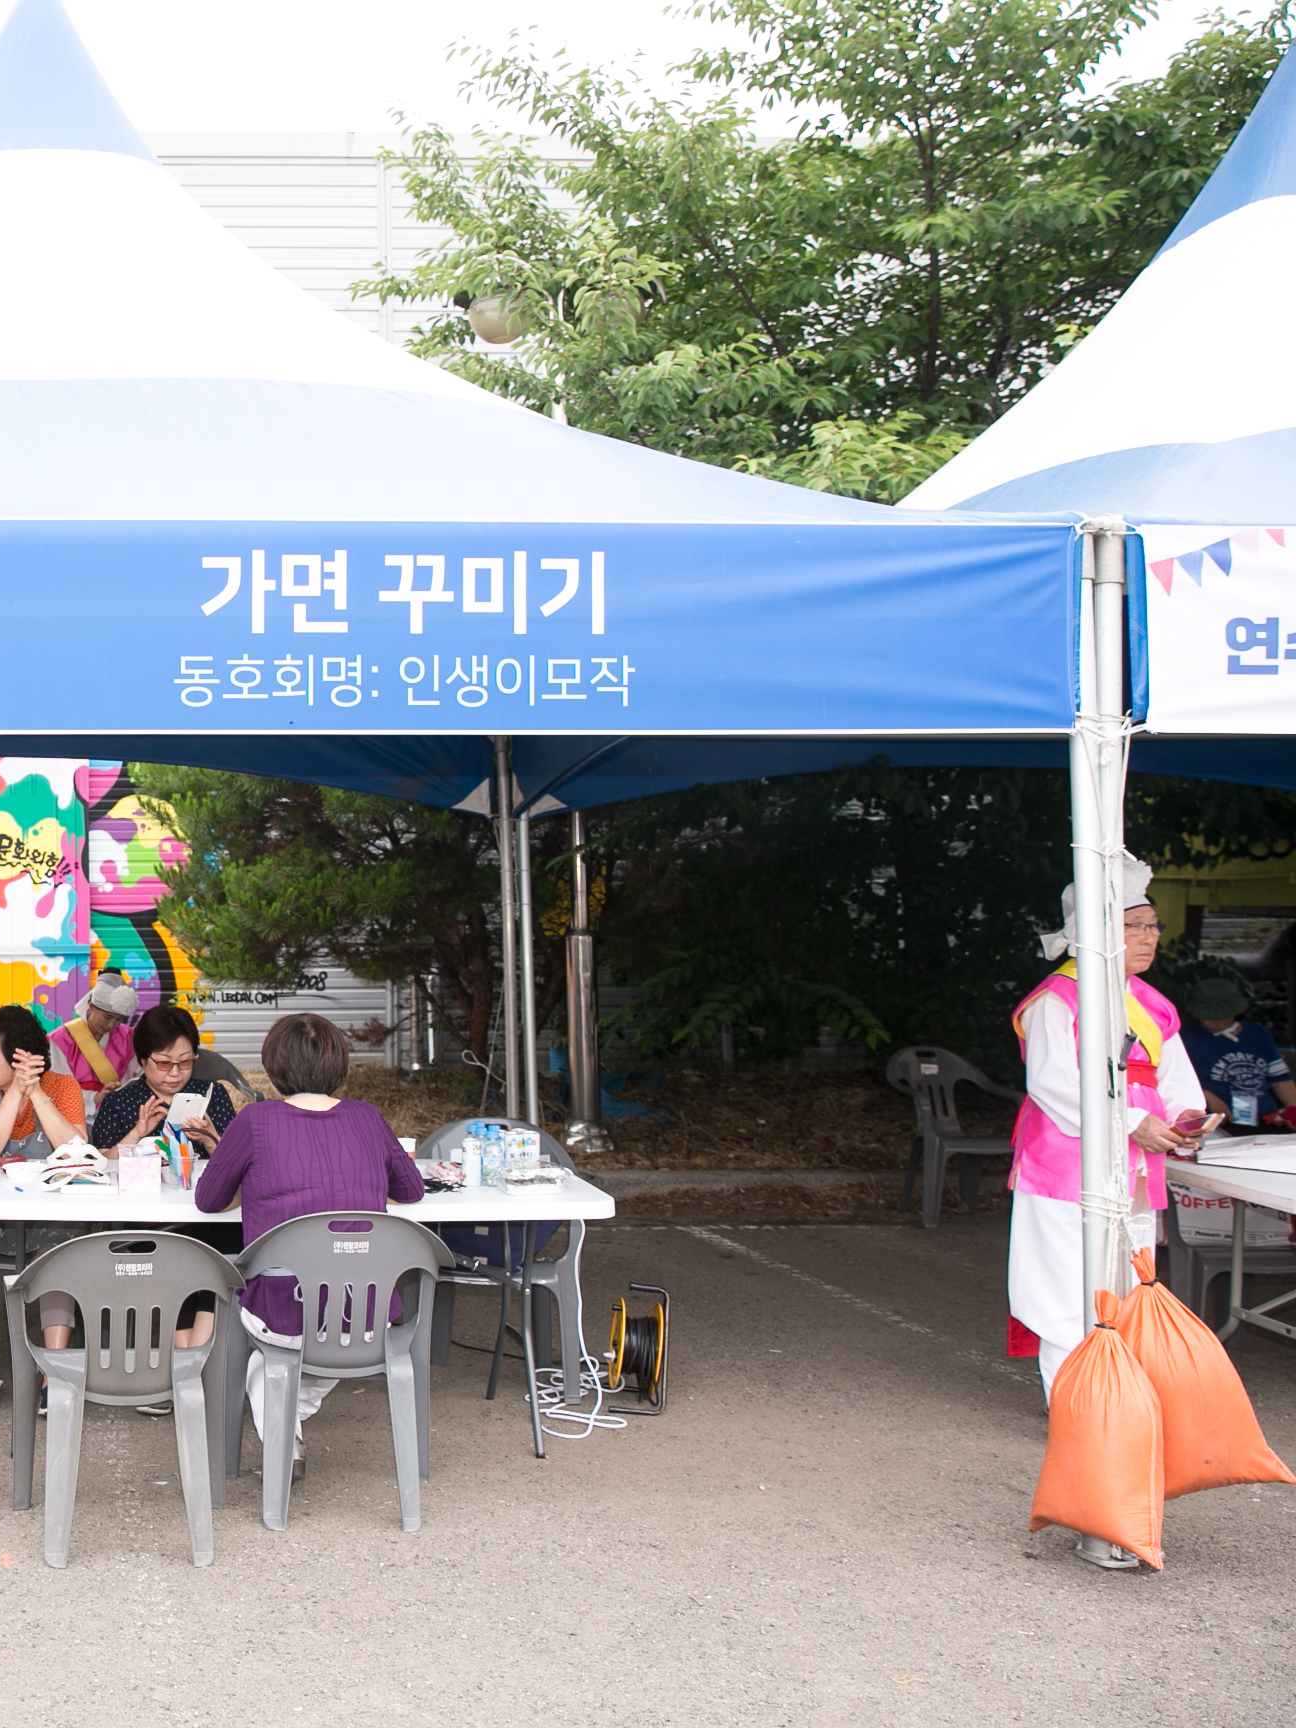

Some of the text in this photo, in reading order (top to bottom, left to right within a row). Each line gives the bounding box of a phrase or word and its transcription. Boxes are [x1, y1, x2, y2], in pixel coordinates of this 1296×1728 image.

[200, 549, 605, 635] 가면 꾸미기
[1225, 616, 1296, 676] 연
[173, 653, 636, 708] 동호회명: 인생이모작
[1209, 1058, 1228, 1082] NEW
